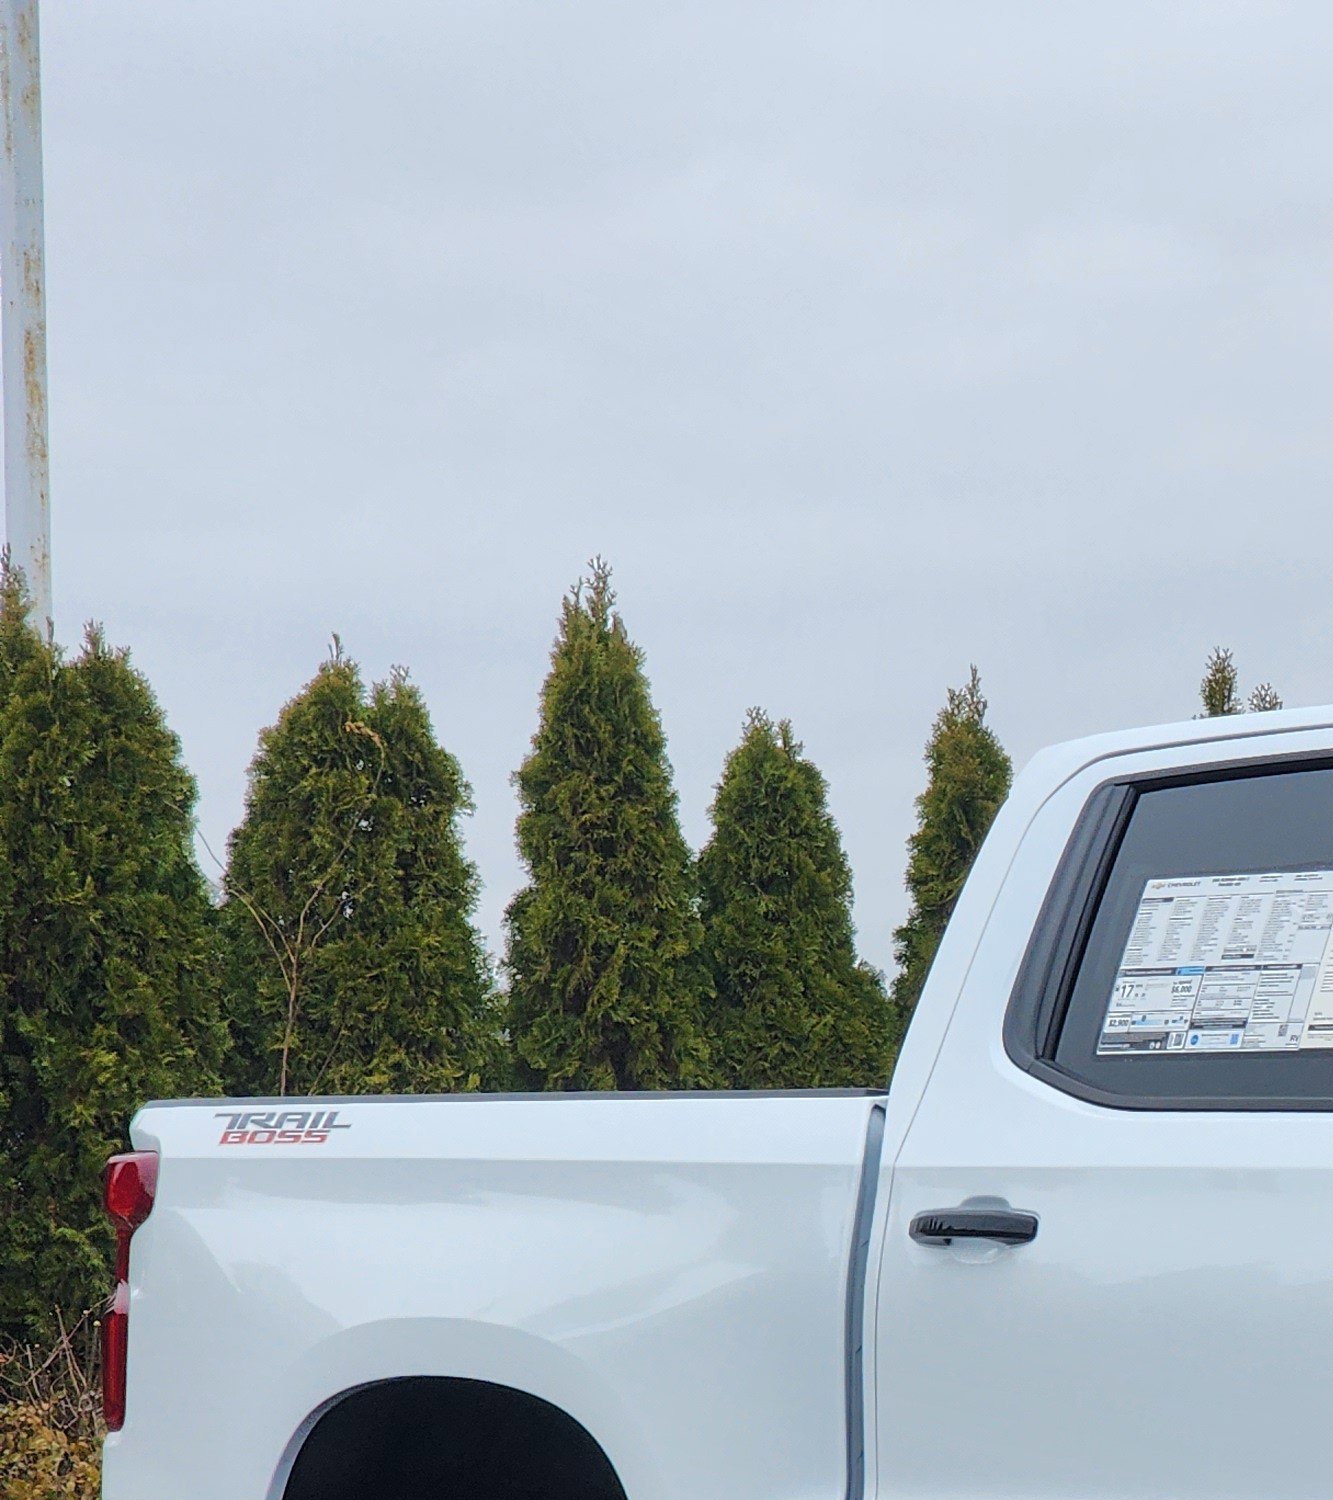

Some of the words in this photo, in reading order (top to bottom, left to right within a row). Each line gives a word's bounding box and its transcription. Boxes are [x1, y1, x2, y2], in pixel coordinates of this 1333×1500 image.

[1121, 984, 1135, 998] 17
[214, 1111, 352, 1130] TRAIL
[219, 1129, 331, 1145] BOSS
